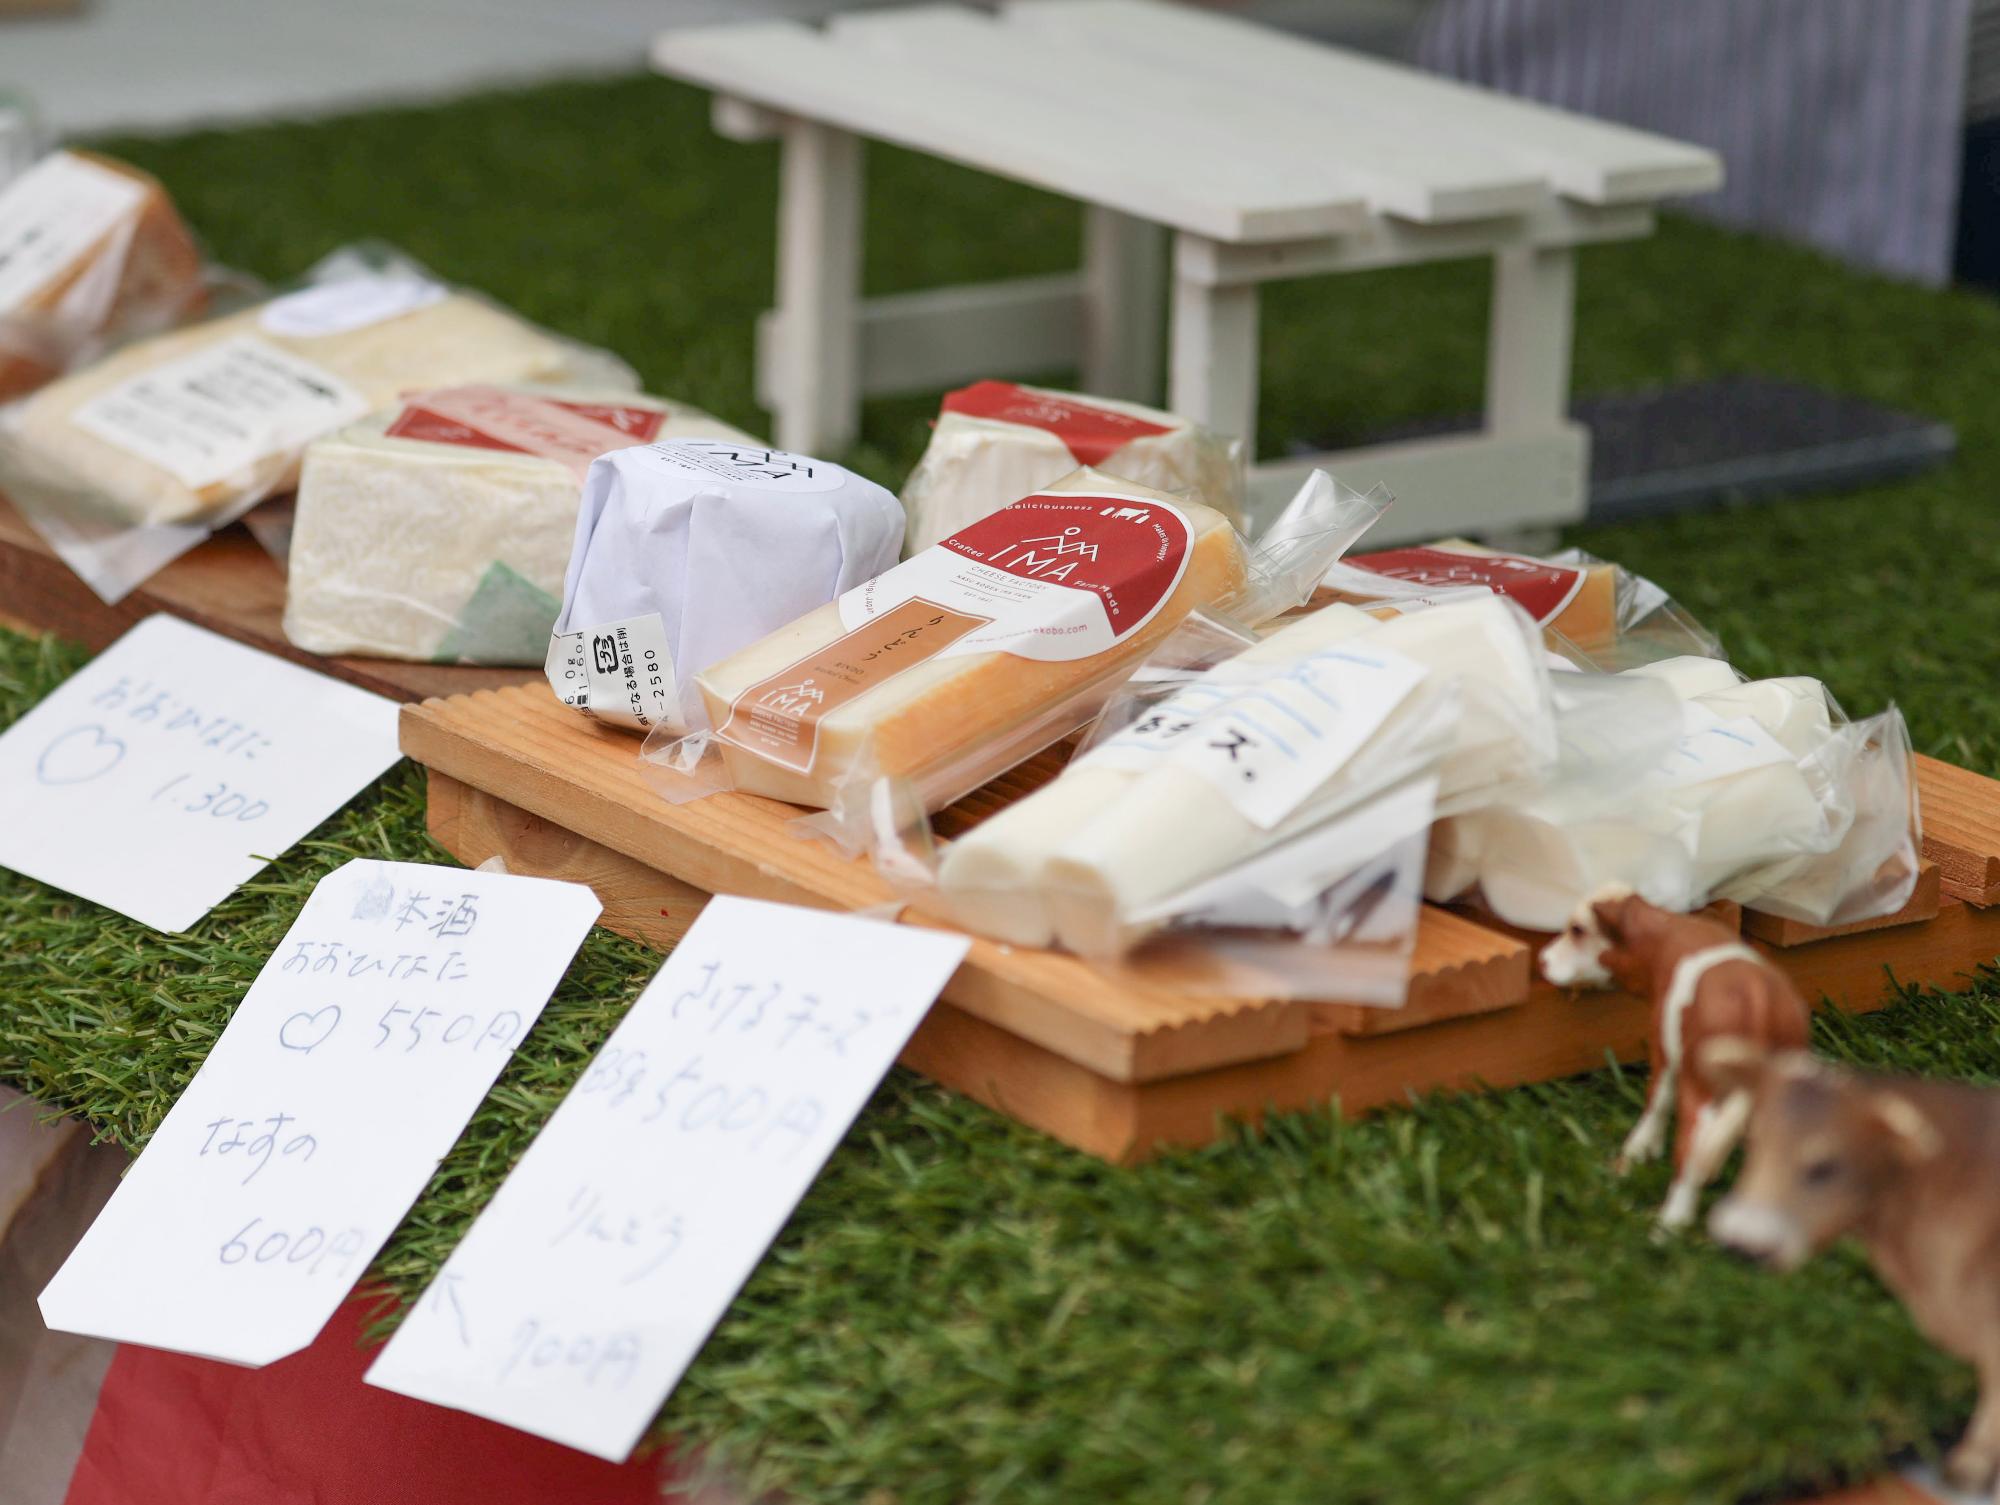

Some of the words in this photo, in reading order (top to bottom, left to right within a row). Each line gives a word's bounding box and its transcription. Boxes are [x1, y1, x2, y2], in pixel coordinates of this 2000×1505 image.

[1005, 502, 1094, 511] Deliciousness
[948, 538, 985, 558] Crafted
[988, 544, 1079, 582] IMA
[970, 565, 1006, 581] CHEESE
[1073, 580, 1098, 589] Farm
[1099, 584, 1120, 616] Made
[759, 690, 812, 717] IMA
[374, 1000, 521, 1052] 550円
[199, 1112, 318, 1187] なすの
[219, 1217, 364, 1278] 600円
